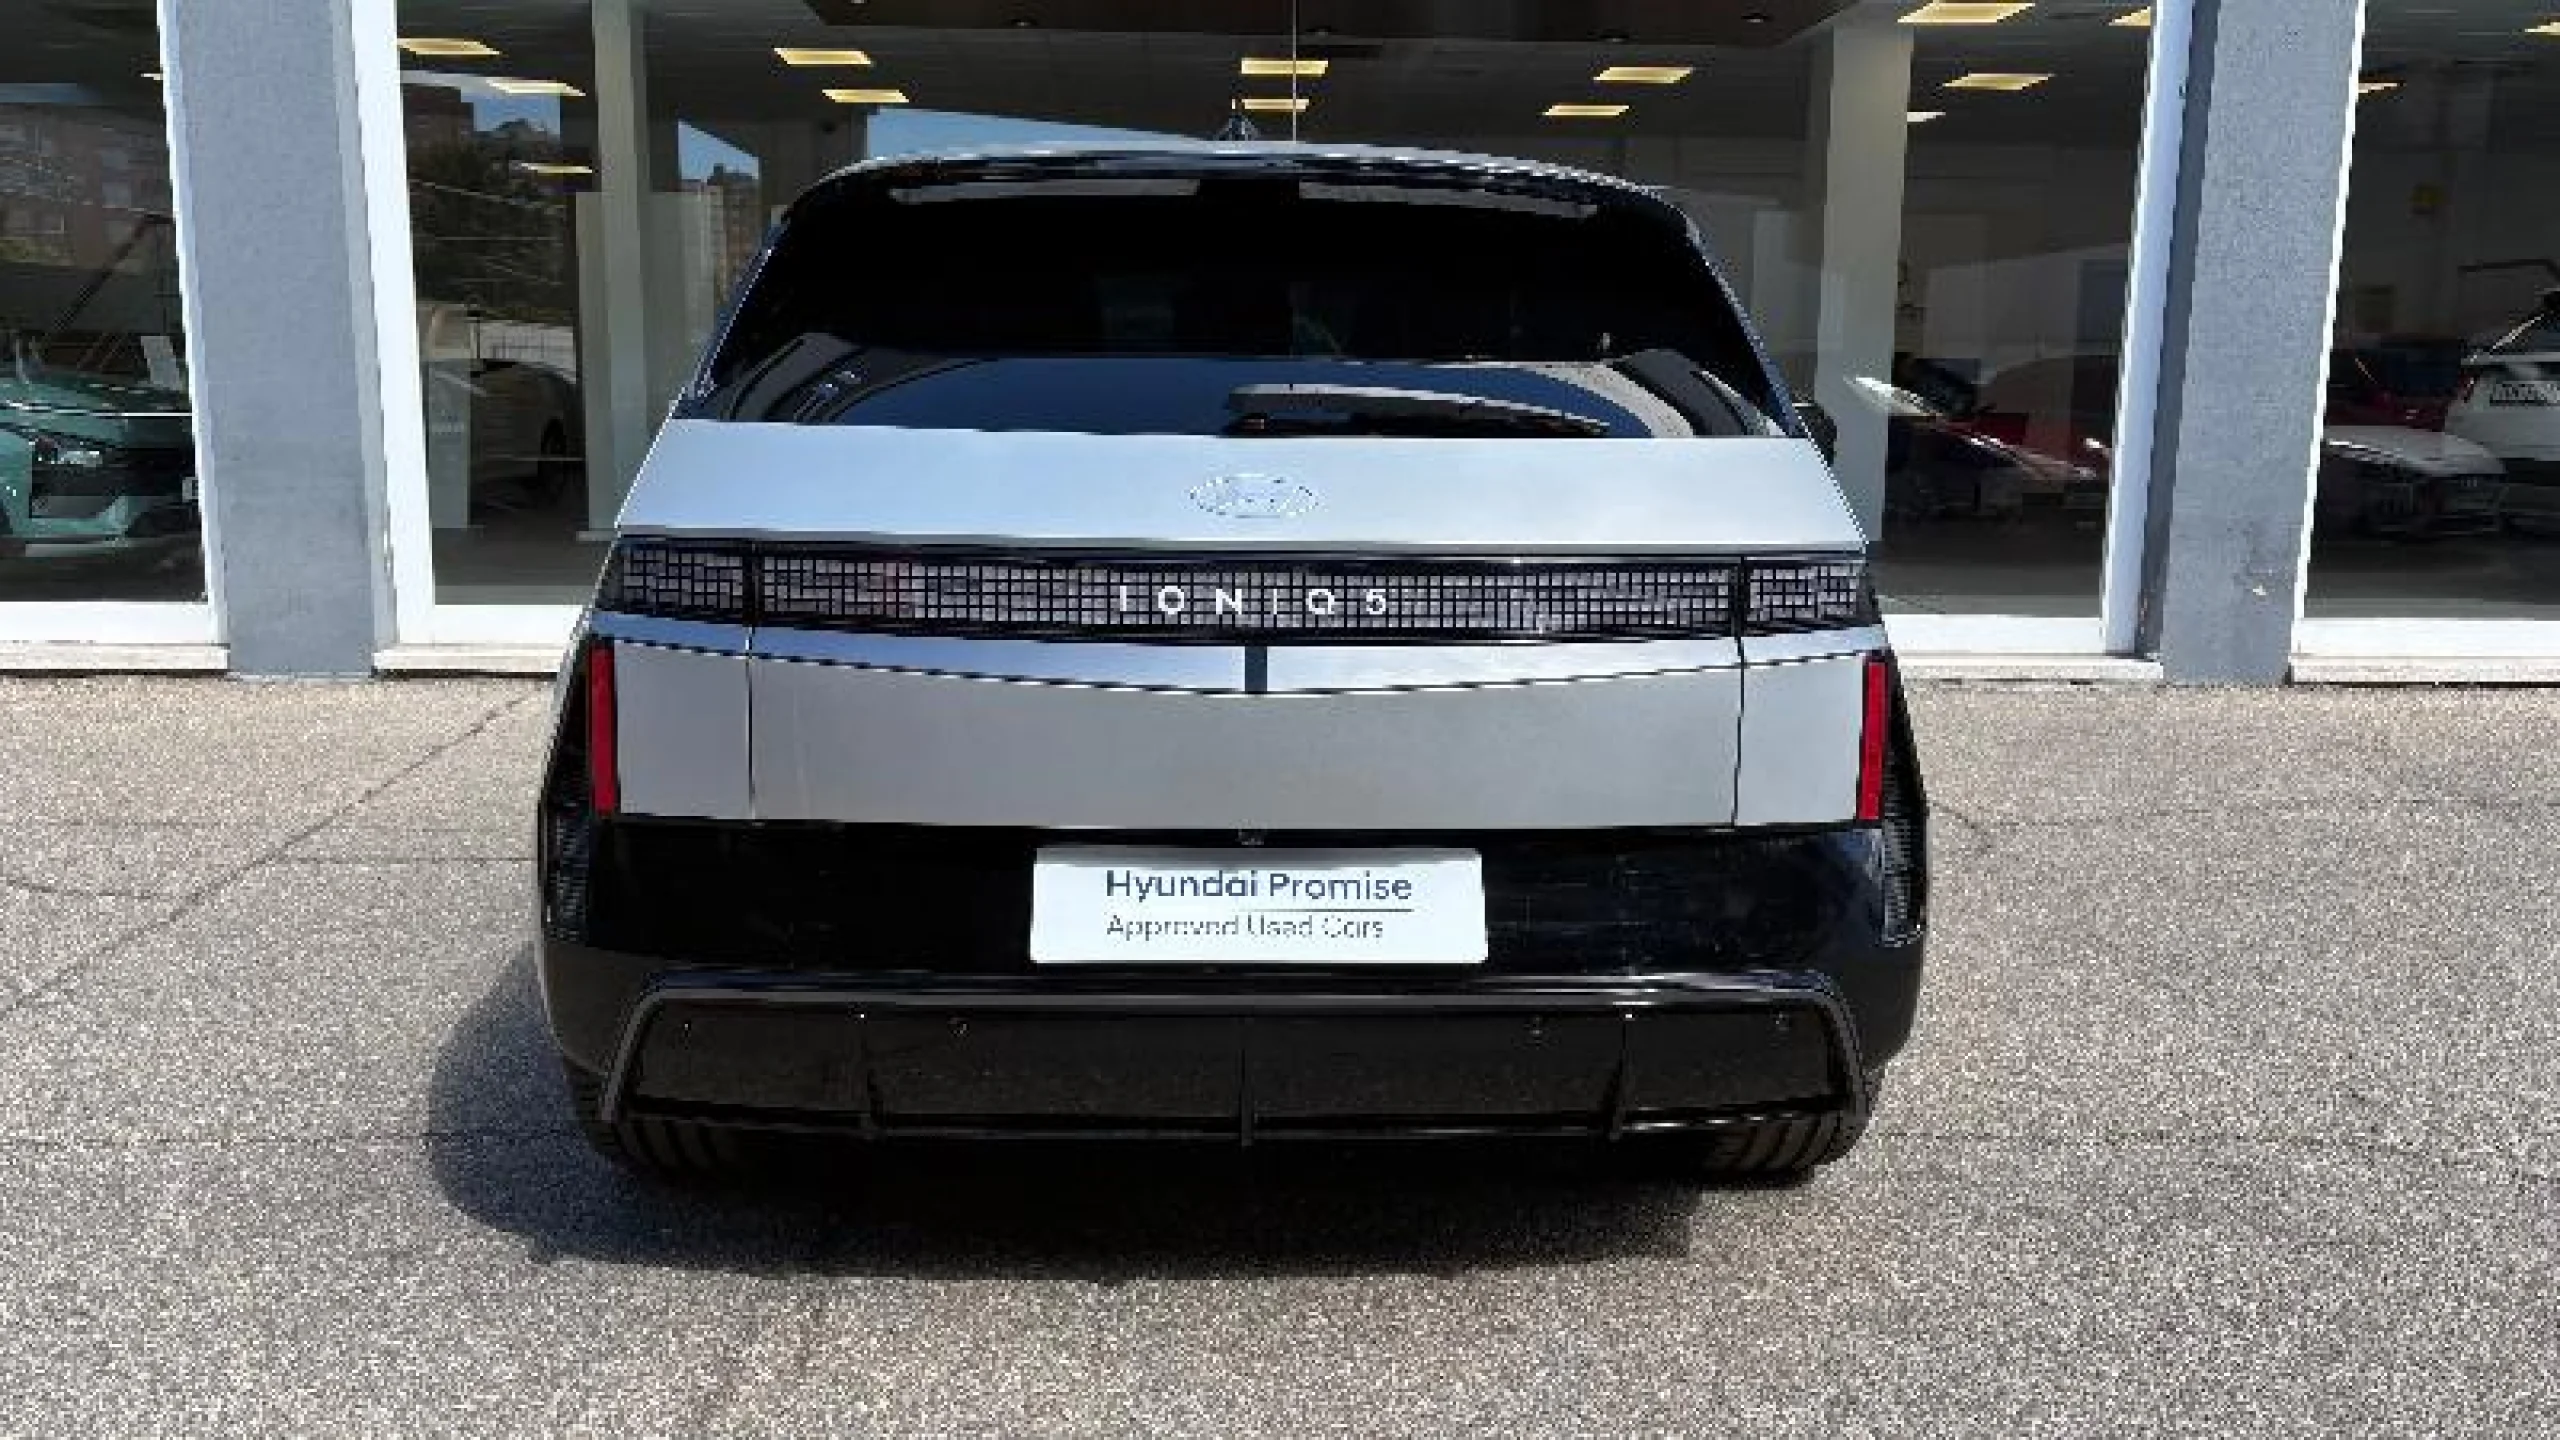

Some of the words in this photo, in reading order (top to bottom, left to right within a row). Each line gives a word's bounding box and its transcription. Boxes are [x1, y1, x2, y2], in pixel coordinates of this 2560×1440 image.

[1106, 869, 1258, 903] Hyundai
[1269, 869, 1412, 900] Promise
[1106, 914, 1239, 942] Approved
[1247, 914, 1313, 938] Used
[1321, 914, 1384, 939] Cars
